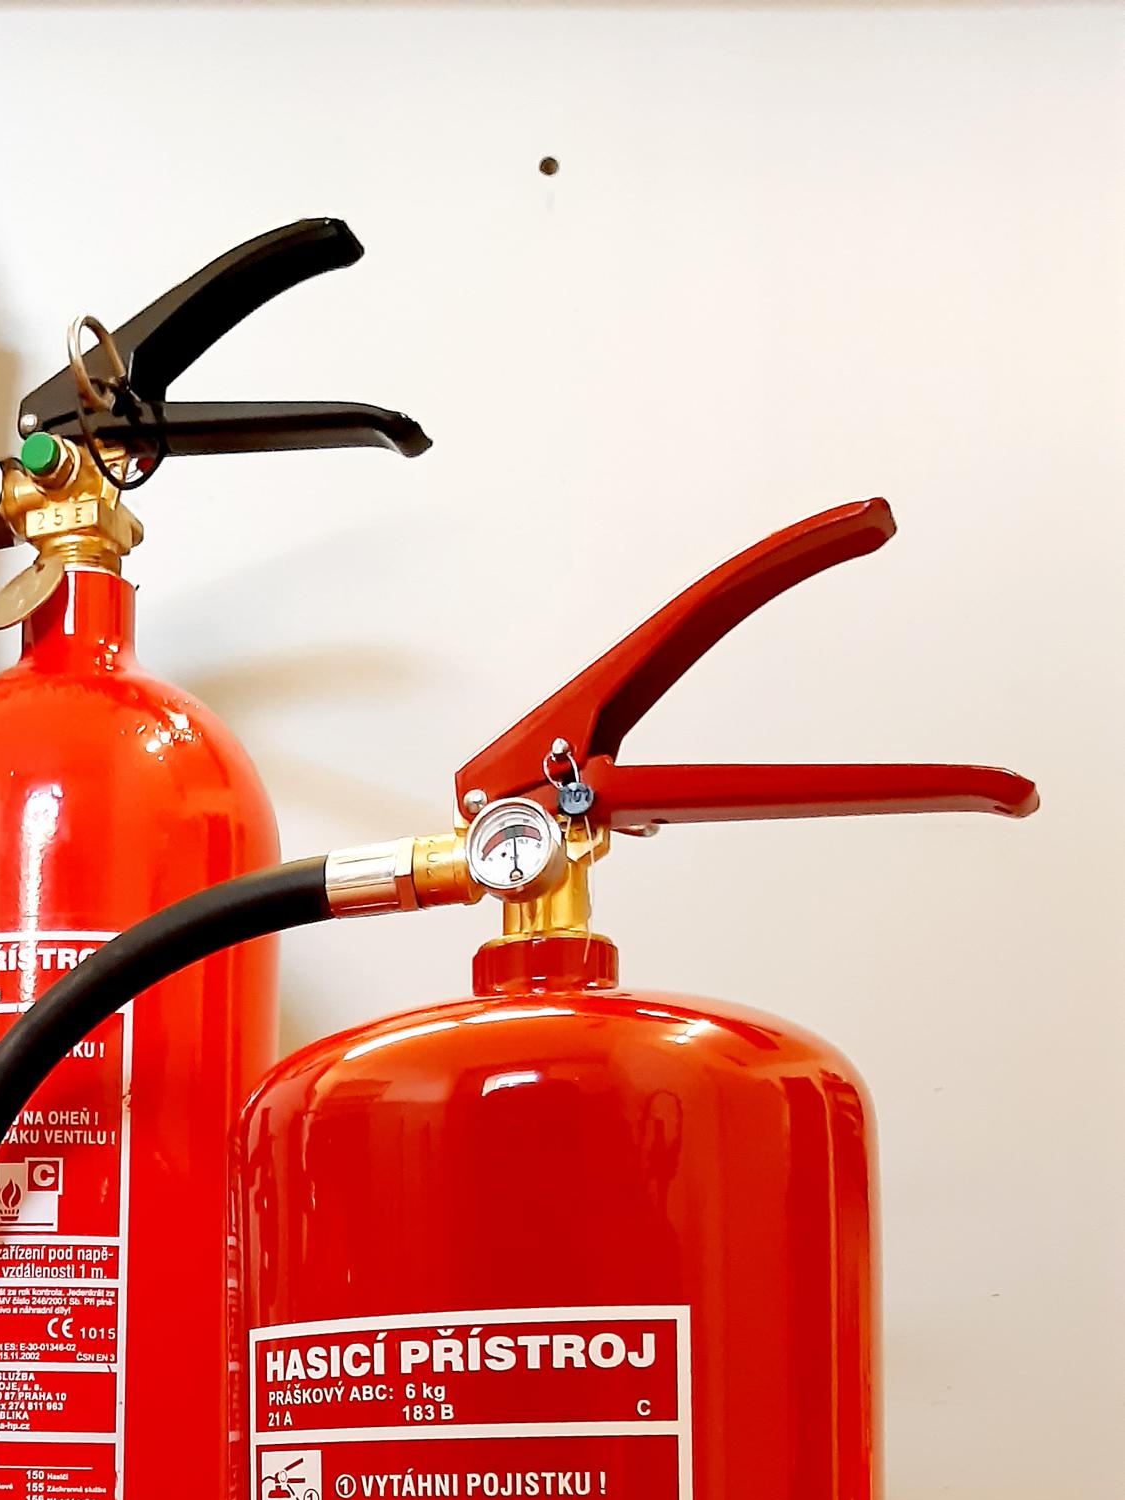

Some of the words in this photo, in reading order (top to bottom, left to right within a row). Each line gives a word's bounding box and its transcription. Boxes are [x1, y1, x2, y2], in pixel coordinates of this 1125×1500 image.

[48, 1107, 91, 1125] OHEŇ
[43, 1129, 107, 1145] VENTILU
[32, 1164, 56, 1187] C
[48, 1246, 73, 1263] pod
[76, 1247, 114, 1263] napě-
[1, 1264, 75, 1279] vzdálenosti
[79, 1327, 116, 1340] 1015
[265, 1331, 387, 1384] HASICÍ
[398, 1327, 657, 1376] PŘÍSTROJ
[17, 1392, 53, 1400] PRAHA
[267, 1380, 345, 1407] PRÁŠKOVÝ
[348, 1385, 395, 1403] ABC:
[404, 1382, 417, 1400] 6
[421, 1382, 447, 1403] kg
[267, 1411, 281, 1427] 21
[281, 1412, 294, 1427] A
[402, 1405, 437, 1422] 183
[440, 1403, 455, 1421] B
[635, 1399, 652, 1416] C
[26, 1470, 45, 1480] 150
[360, 1467, 461, 1498] VYTÁHNI
[466, 1471, 593, 1498] POJISTKU
[26, 1482, 45, 1492] 155
